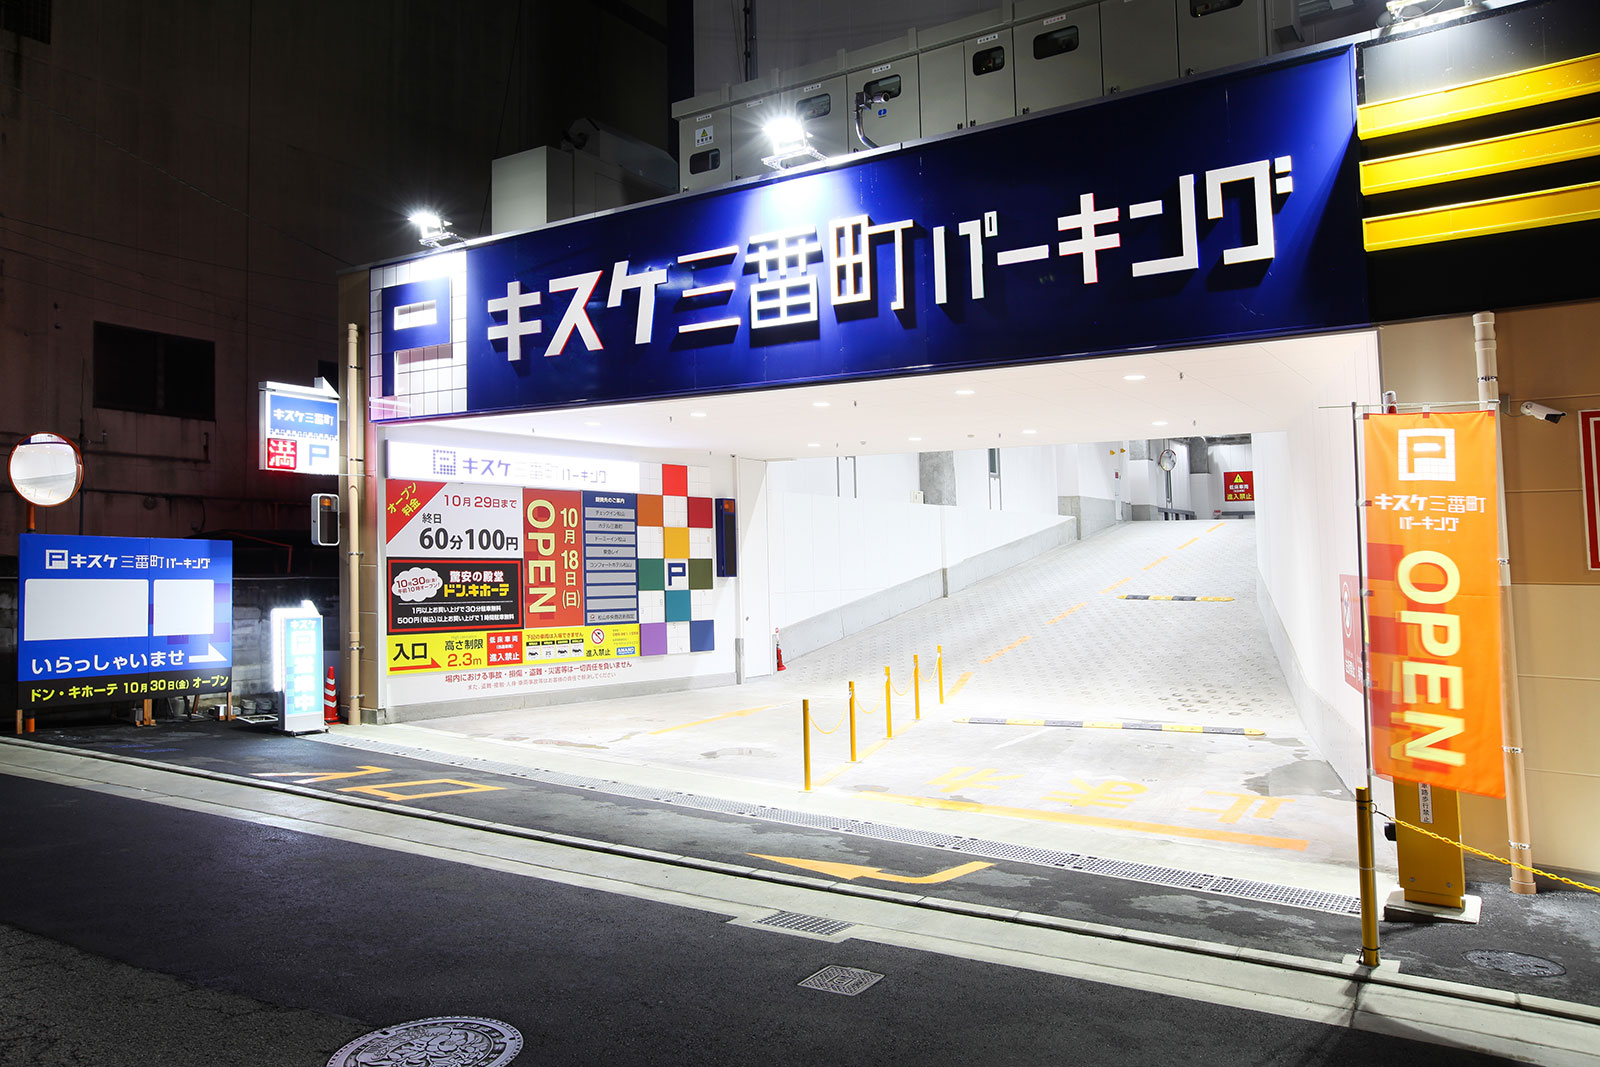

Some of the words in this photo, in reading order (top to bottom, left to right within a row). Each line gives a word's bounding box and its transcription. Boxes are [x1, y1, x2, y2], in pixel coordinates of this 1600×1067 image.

[487, 155, 1293, 362] キスケ三番町パーキング
[273, 407, 334, 426] キスケ三番町
[268, 440, 297, 468] 満
[309, 443, 330, 466] P
[387, 481, 417, 514] オープン
[401, 497, 421, 517] 料金
[444, 494, 517, 508] 10月29日まで
[1374, 493, 1487, 513] キスケ三番町
[421, 512, 442, 524] 終日
[1399, 516, 1460, 531] パーキング
[419, 527, 518, 551] 60分100円
[71, 553, 211, 569] キスケ三番町パーキング
[526, 499, 557, 613] OPEN
[560, 507, 581, 609] 10月18日(日)
[449, 570, 504, 583] 驚安の殿堂
[668, 562, 686, 587] P
[393, 642, 428, 661] 入口
[444, 639, 484, 651] 高さ制限
[585, 648, 611, 657] 進入禁止
[32, 650, 185, 675] いらっしゃいませ
[447, 652, 482, 667] 2.3m
[489, 652, 520, 662] 進入禁止
[1397, 549, 1467, 768] OPEN
[30, 682, 118, 702] ドン・キホーテ
[124, 678, 190, 694] 10月30日(金)
[192, 674, 229, 689] オープン
